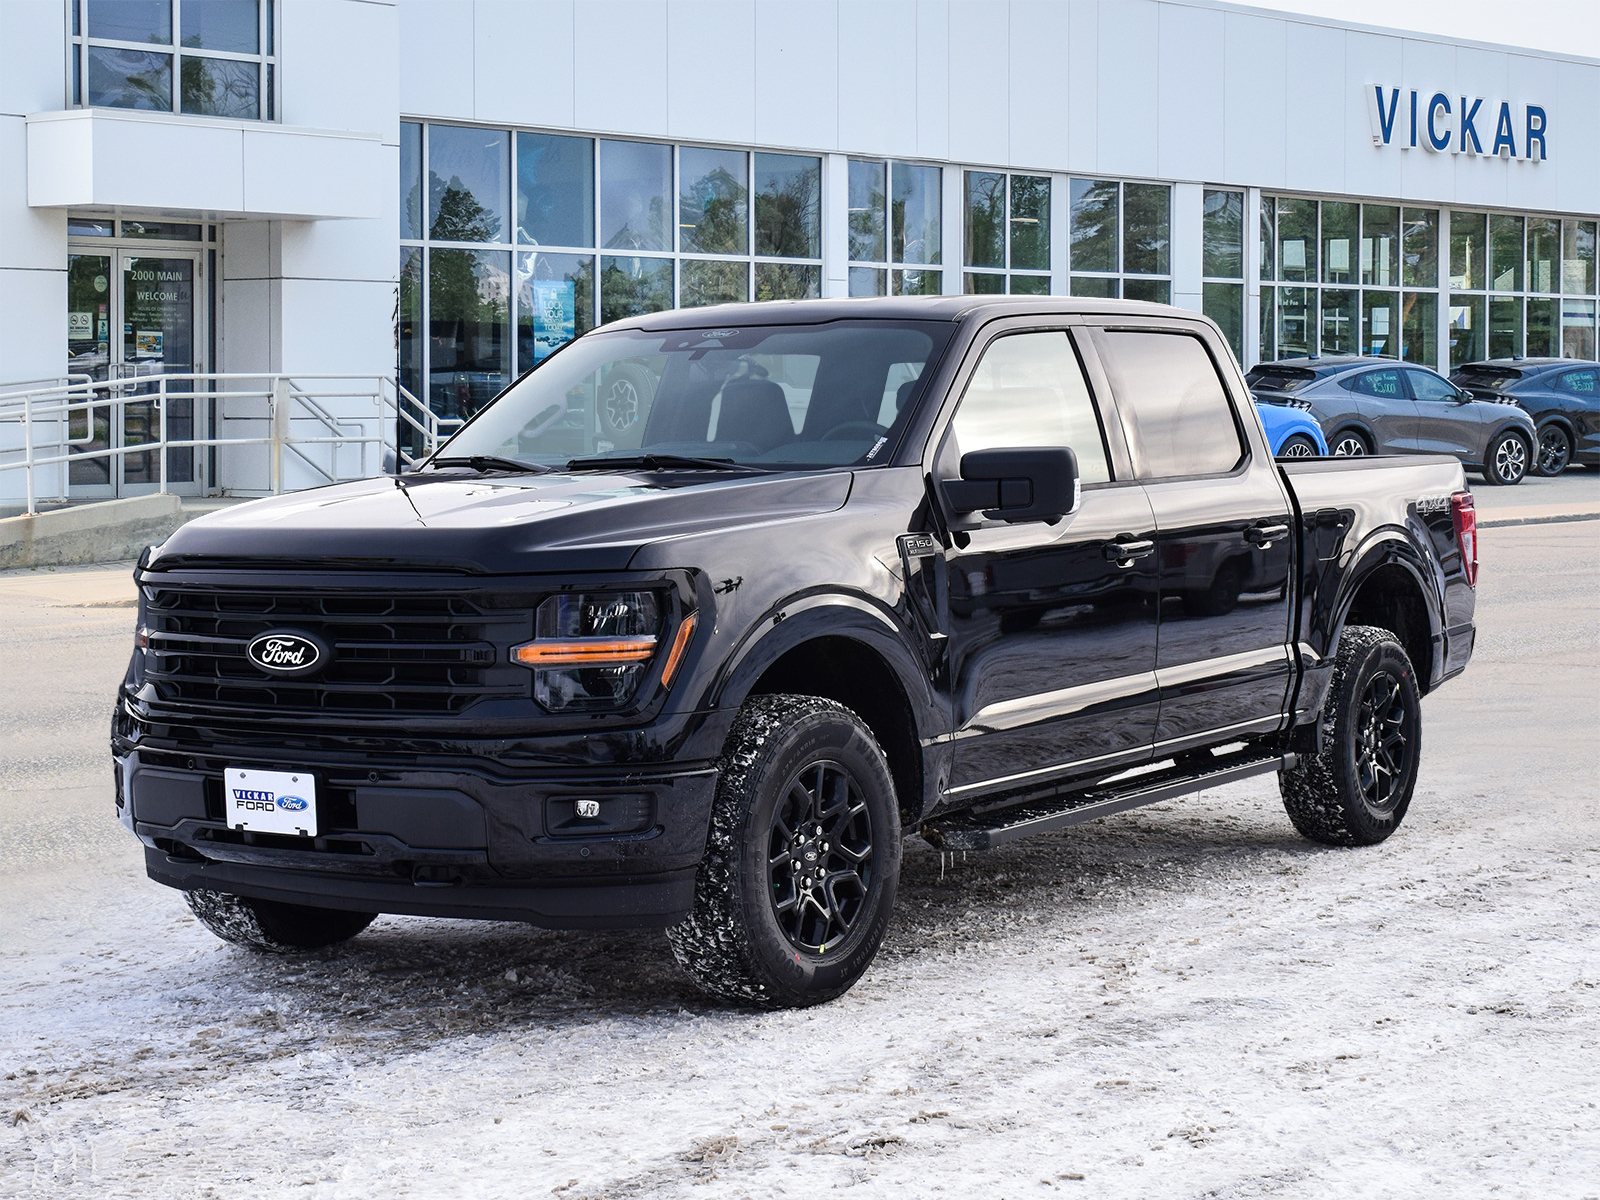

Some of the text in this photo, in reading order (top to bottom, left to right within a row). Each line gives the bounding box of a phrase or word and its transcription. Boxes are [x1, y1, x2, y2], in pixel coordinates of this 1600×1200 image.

[1373, 84, 1547, 161] VICKAR
[131, 270, 183, 282] 2000 MAIN
[136, 291, 178, 301] WELCOME
[543, 310, 564, 319] YOUR
[906, 539, 933, 549] F-150
[262, 639, 305, 664] Ford
[234, 789, 274, 802] VICKAR
[236, 800, 275, 812] FORD
